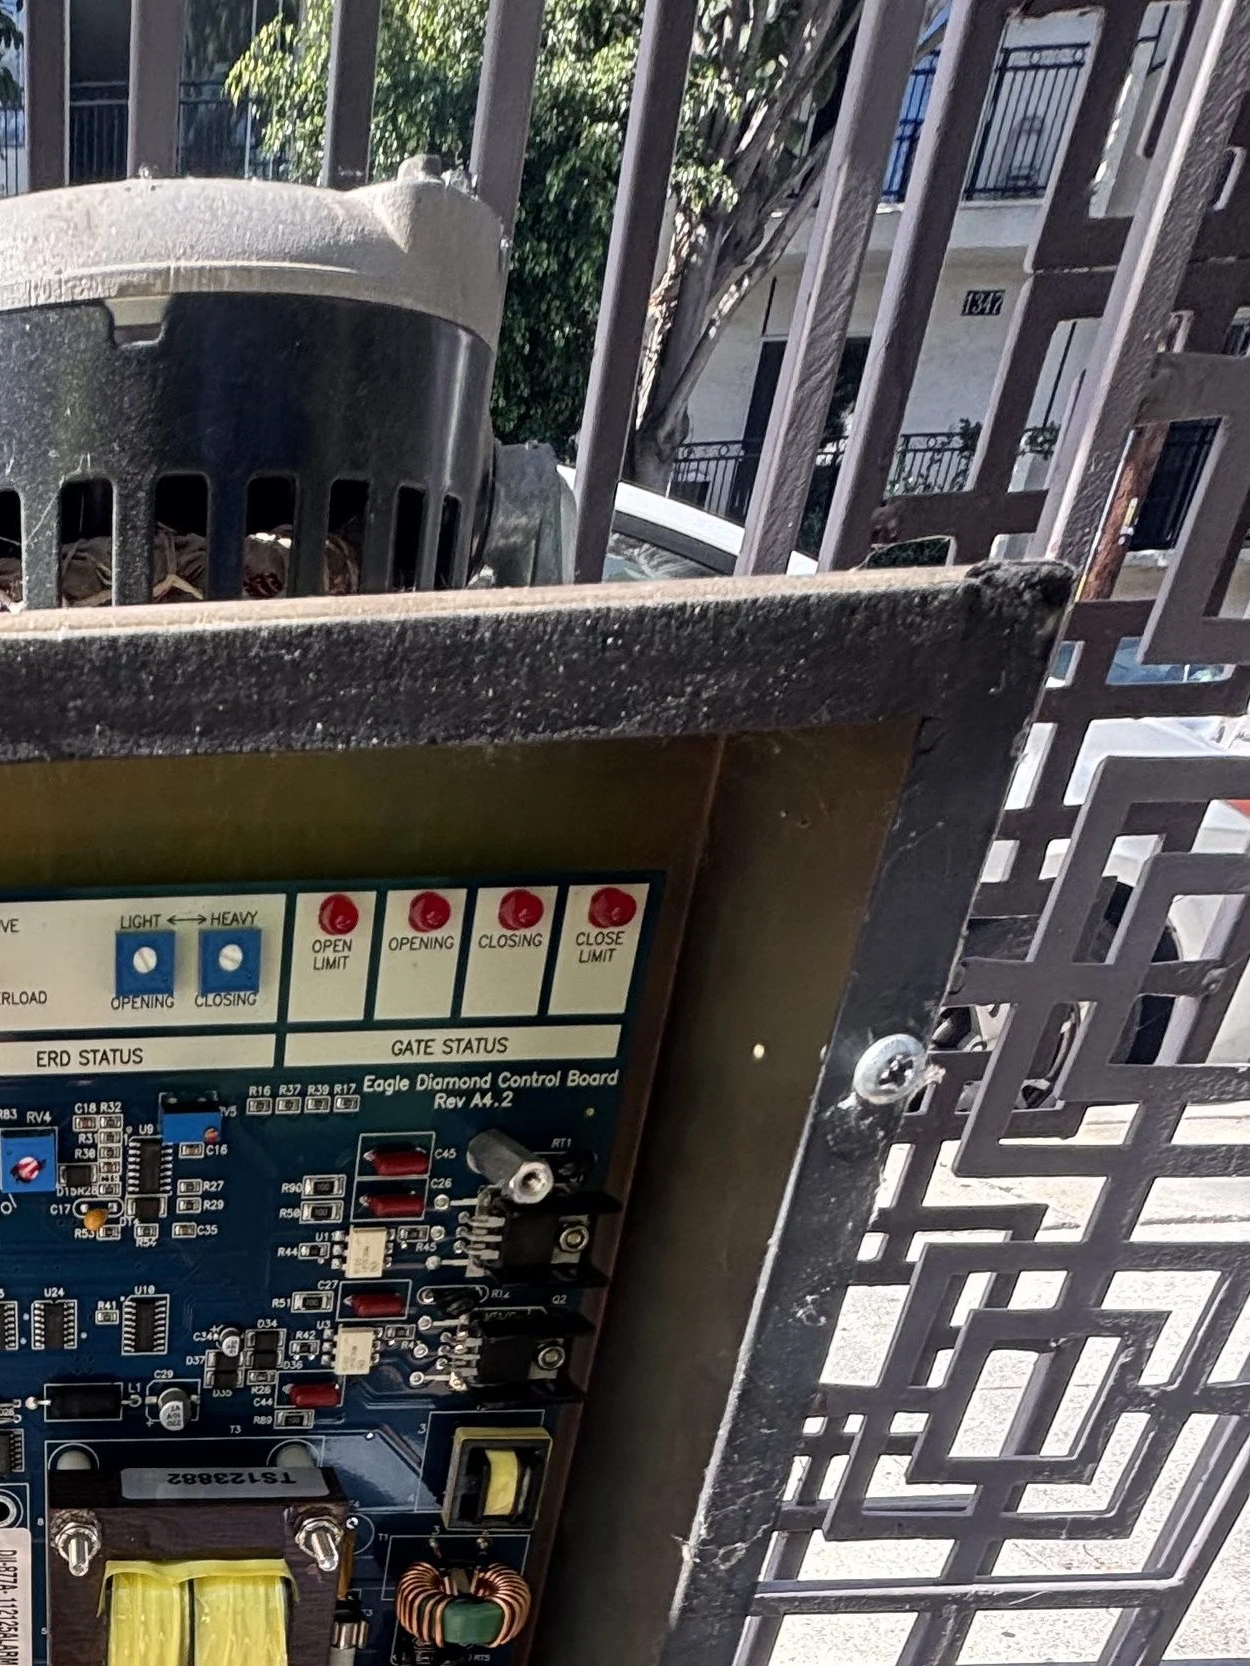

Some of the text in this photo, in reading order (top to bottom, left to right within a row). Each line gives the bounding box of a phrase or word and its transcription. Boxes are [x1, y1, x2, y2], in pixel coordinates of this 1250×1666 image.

[120, 912, 258, 930] LIGHT HEAVY
[388, 936, 455, 951] OPENING
[479, 934, 543, 948] CLOSING
[575, 931, 624, 946] CLOSE
[312, 939, 352, 953] OPEN
[578, 949, 614, 963] LIMIT
[313, 956, 350, 970] LIMIT
[110, 993, 175, 1010] OPENING
[194, 992, 257, 1008] CLOSING
[391, 1037, 508, 1056] GATE STATUS
[36, 1049, 144, 1067] ERD STATUS
[363, 1069, 619, 1095] Eagle Diamond Control Board
[249, 1086, 270, 1096] R16
[279, 1084, 301, 1095] R37
[307, 1084, 329, 1095] R39
[334, 1084, 355, 1094] R17
[434, 1092, 513, 1109] Rev A4.2
[75, 1103, 96, 1114] C18
[100, 1102, 121, 1113] R32
[26, 1111, 51, 1123] RV4
[203, 1181, 224, 1191] R27
[282, 1182, 302, 1193] R90
[50, 1204, 70, 1214] C17
[203, 1200, 224, 1210] R29
[197, 1225, 218, 1235] C35
[318, 1280, 338, 1289] C27
[44, 1288, 64, 1297] U24
[257, 1319, 278, 1328] D34
[186, 1356, 205, 1365] D37
[154, 1370, 173, 1378] C29
[128, 1383, 141, 1393] L1
[230, 1425, 241, 1433] T3
